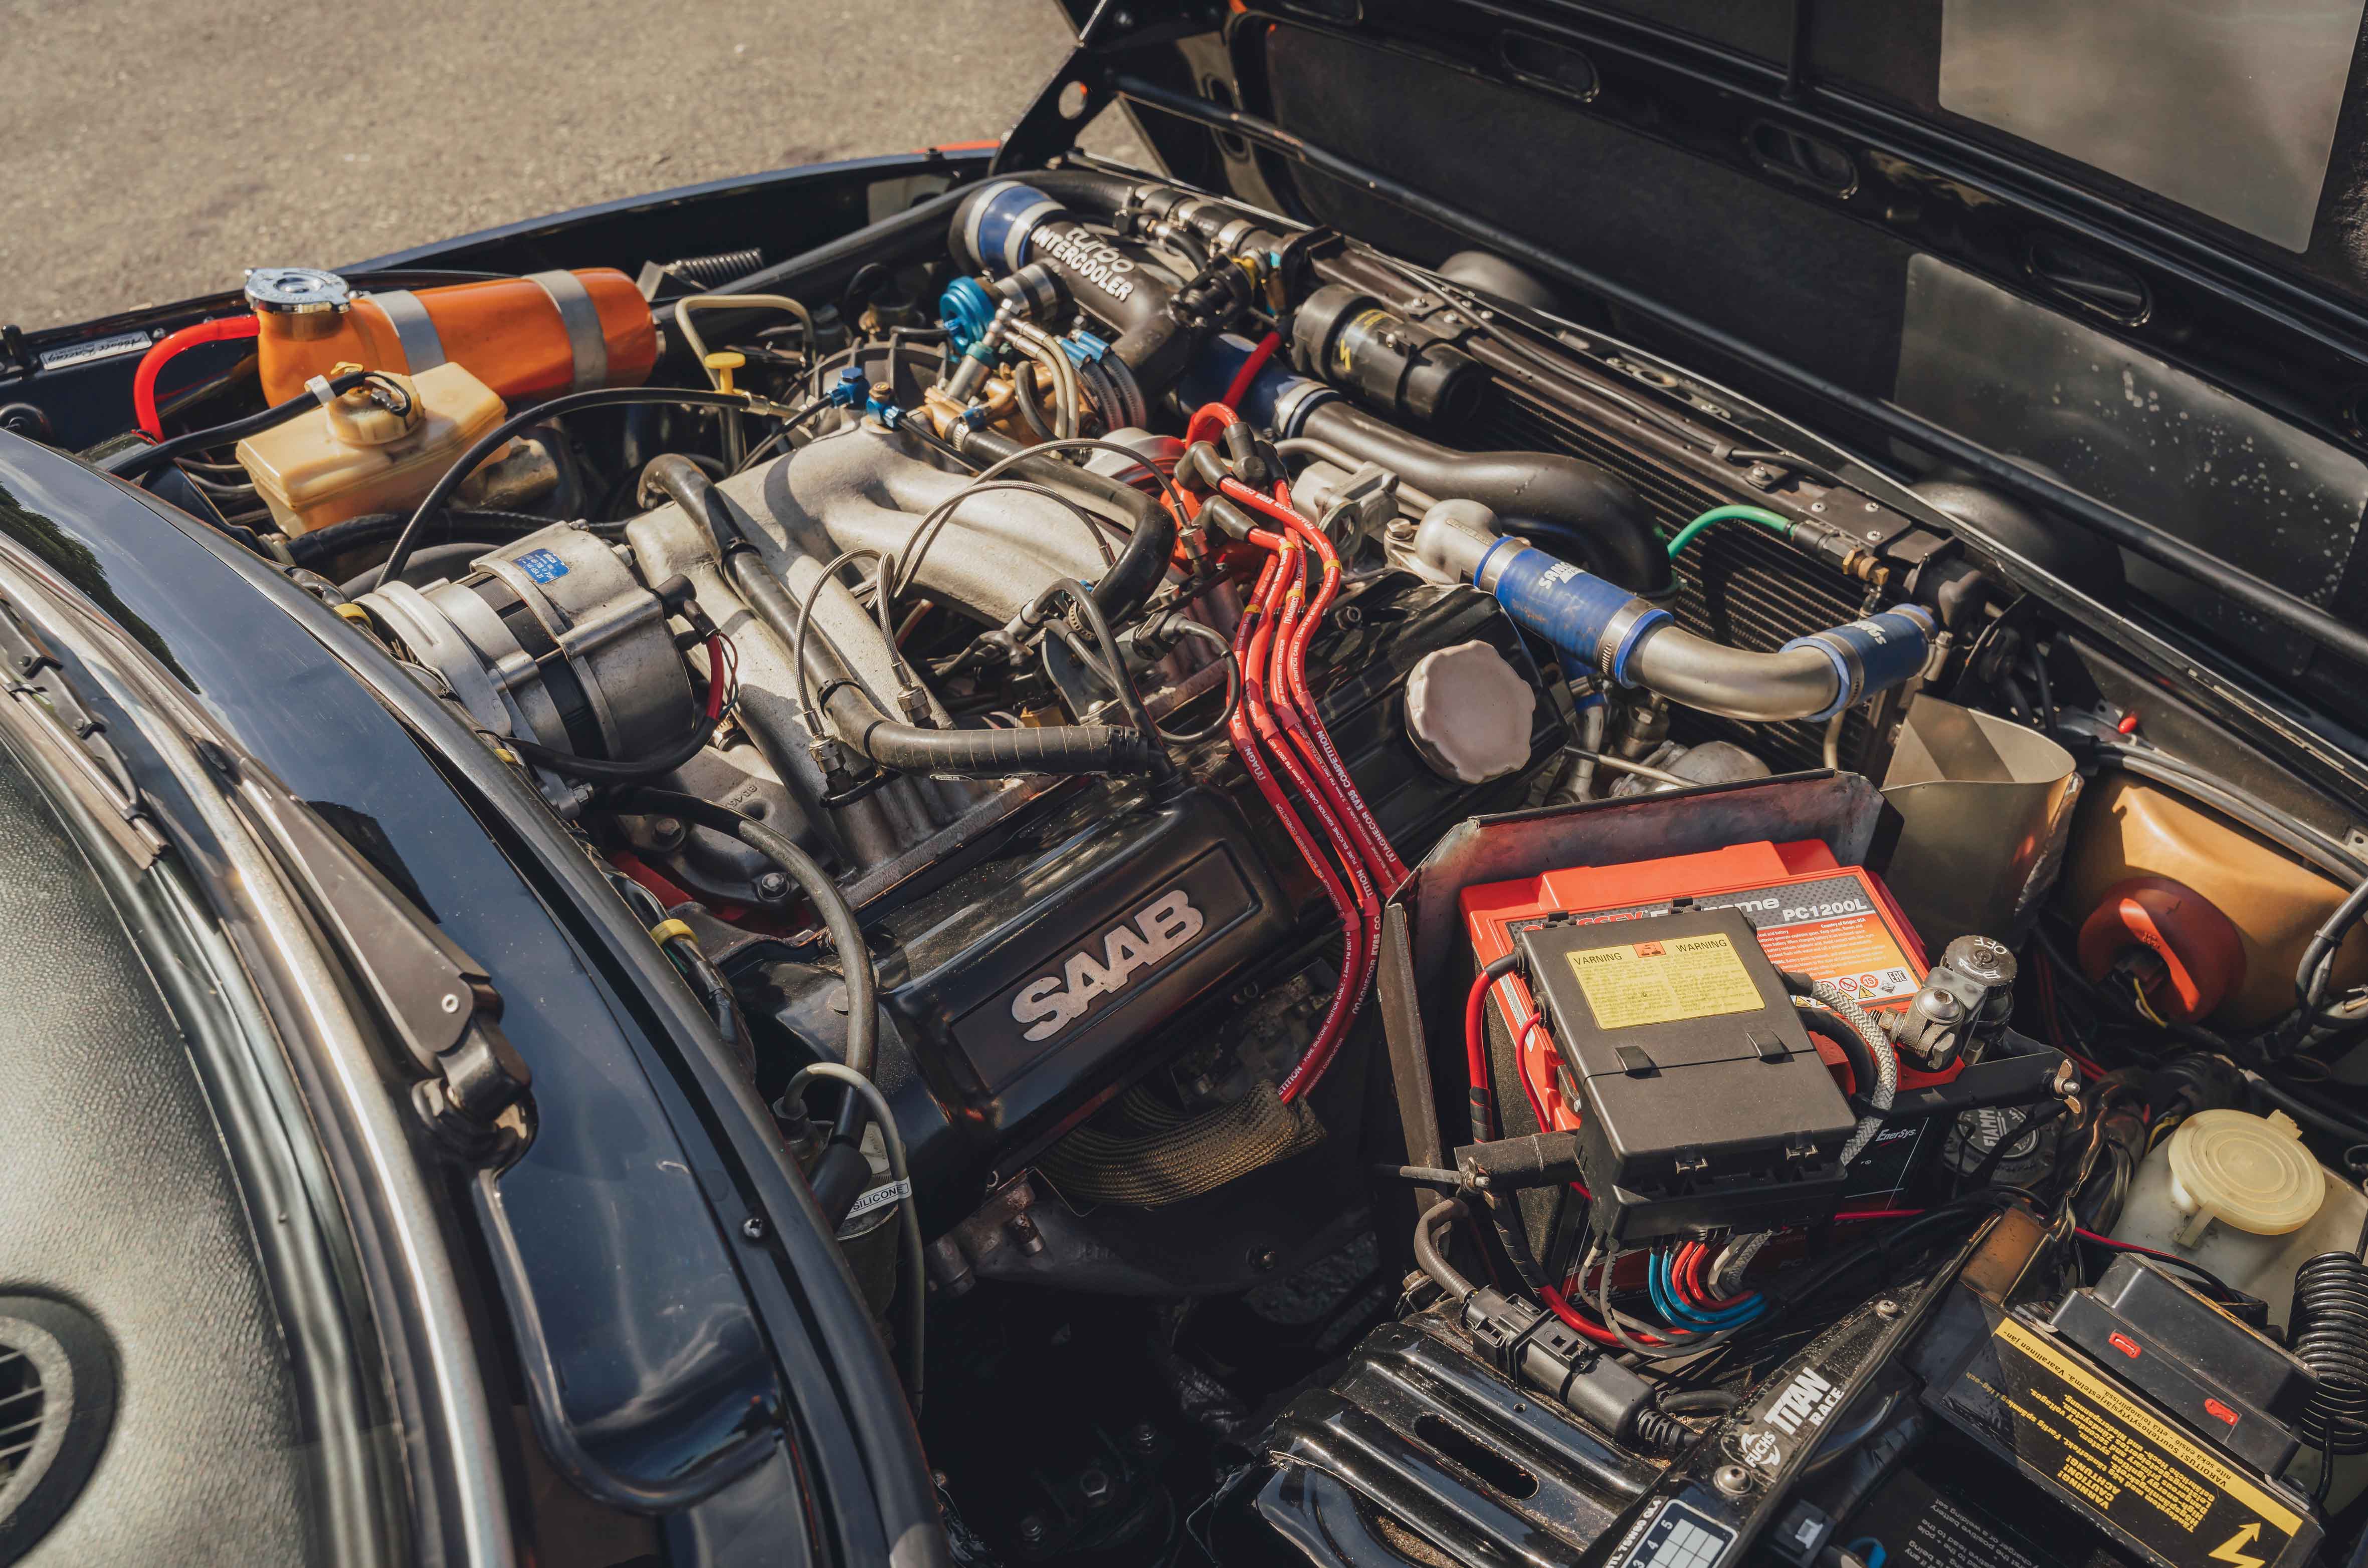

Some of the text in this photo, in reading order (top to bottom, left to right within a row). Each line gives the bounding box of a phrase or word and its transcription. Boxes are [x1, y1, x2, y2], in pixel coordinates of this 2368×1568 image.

[1028, 222, 1136, 303] INTERCOOLER
[1283, 594, 1300, 625] MAGNECO
[1307, 712, 1318, 725] PUR
[1305, 739, 1323, 765] METALLIC
[1313, 729, 1353, 789] COMPETITION
[1304, 786, 1320, 806] CABLE
[1316, 802, 1335, 828] IGNITION
[1346, 805, 1359, 823] CABLE
[1331, 826, 1349, 851] SILICONE
[1356, 822, 1373, 846] IGNITION
[1361, 810, 1397, 863] MAGNECOR
[1274, 801, 1344, 911] INDUCTANCE EMI SUPPRESSED CONDUCTOR
[1346, 849, 1358, 865] PURE
[1370, 845, 1387, 869] SILICONE
[1781, 897, 1867, 922] PC1200L
[1676, 939, 1727, 952] WARNING
[1012, 889, 1202, 1038] SAAB
[1573, 952, 1622, 966] VARNING
[1351, 958, 1376, 1014] MAGNECOR
[1863, 977, 1874, 985] 15
[1303, 1047, 1315, 1062] PURE
[1311, 1024, 1329, 1049] SILICONE
[1325, 1000, 1339, 1025] IGNITION
[1335, 981, 1345, 1000] CABLE
[1875, 1129, 1915, 1141] EnerSys
[1978, 1108, 2000, 1147] FIAMM
[850, 1184, 905, 1211] SILICONE
[2001, 1328, 2021, 1345] jän-
[2019, 1341, 2066, 1376] Vaarallinen
[1762, 1367, 1831, 1435] TITAN
[1808, 1387, 1844, 1426] RACE
[2035, 1418, 2064, 1441] Farlig
[2058, 1401, 2116, 1442] Zündsystem.
[2060, 1393, 2129, 1442] Niederspannung.
[2151, 1423, 2168, 1438] että
[1744, 1430, 1776, 1467] FUCHS
[2026, 1387, 2208, 1515] Dangerous primary and secondary voltages.
[2075, 1430, 2111, 1456] system.
[2126, 1438, 2144, 1453] und
[2142, 1449, 2169, 1470] Hoch-
[2180, 1451, 2227, 1487] VAROITUS!
[2195, 1454, 2215, 1470] sekä
[2062, 1463, 2114, 1502] CAUTION!
[2065, 1454, 2121, 1494] ACHTUNG!
[2215, 1467, 2231, 1480] nite
[2056, 1469, 2110, 1510] VARNING!
[2124, 1481, 2144, 1497] med
[2146, 1478, 2204, 1520] High-energy
[1933, 1498, 1950, 1511] set
[1659, 1517, 1674, 1531] 5
[1927, 1502, 2011, 1562] the positive battery
[1948, 1506, 1984, 1532] welding
[1645, 1537, 1660, 1551] 4
[1916, 1524, 1967, 1561] to the pole
[1919, 1517, 1968, 1553] lead to the
[1988, 1534, 2000, 1544] or
[1906, 1538, 1936, 1561] being
[1997, 1540, 2034, 1567] charger
